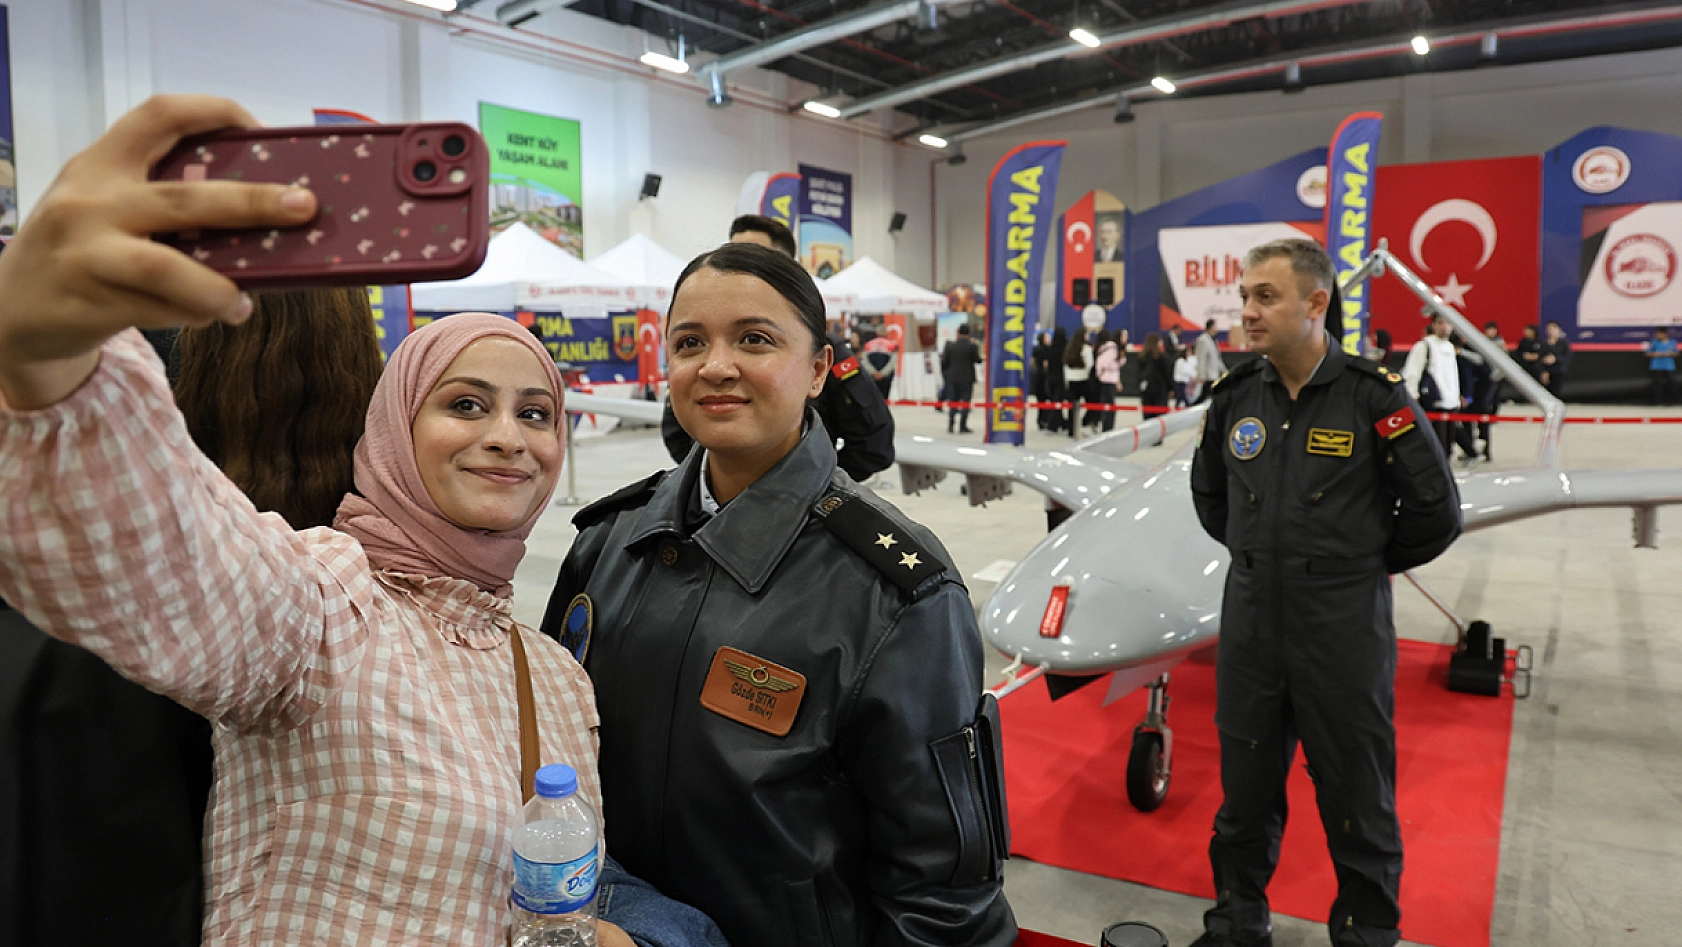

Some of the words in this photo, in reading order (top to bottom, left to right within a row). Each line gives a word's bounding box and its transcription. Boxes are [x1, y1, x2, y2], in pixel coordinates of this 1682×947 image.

[508, 132, 536, 147] KENT
[538, 136, 558, 151] KÖY
[497, 149, 535, 165] YAŞAM
[1337, 142, 1370, 357] ANDARMA
[1003, 165, 1044, 377] JANDARMA
[544, 338, 609, 361] TANLIĞI
